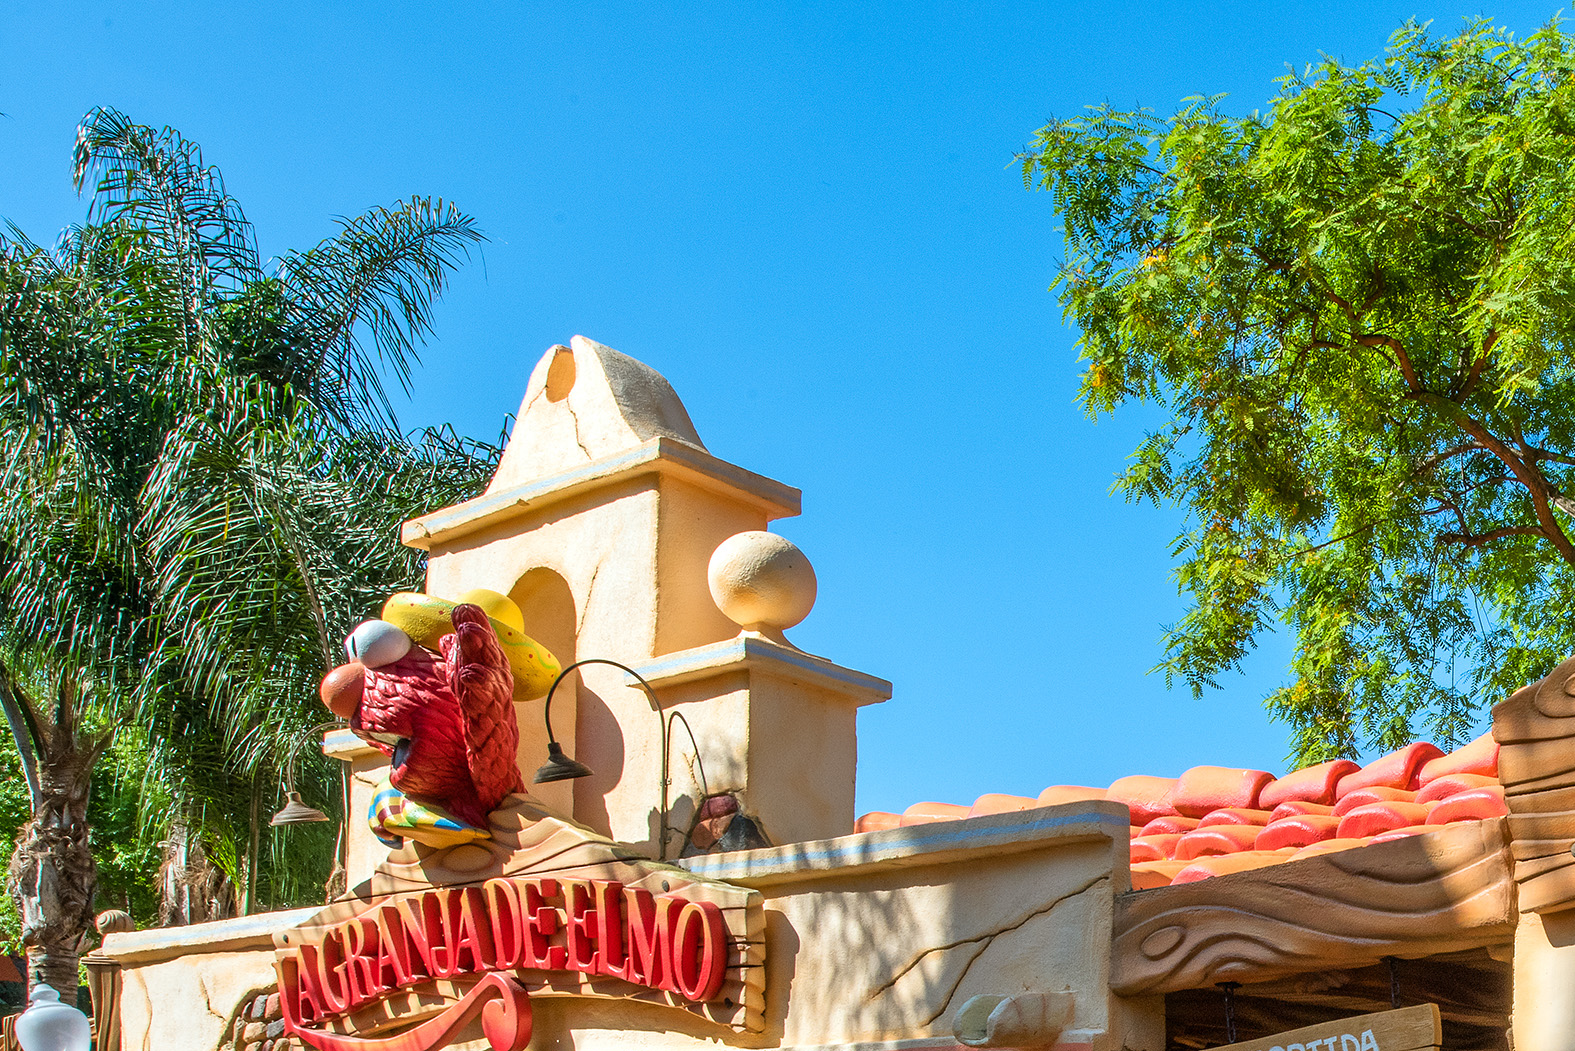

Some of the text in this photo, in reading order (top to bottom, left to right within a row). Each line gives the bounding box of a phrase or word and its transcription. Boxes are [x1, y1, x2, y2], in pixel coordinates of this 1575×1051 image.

[317, 887, 500, 1014] GRANJA
[483, 877, 565, 970] DE
[557, 877, 728, 1000] ELMO
